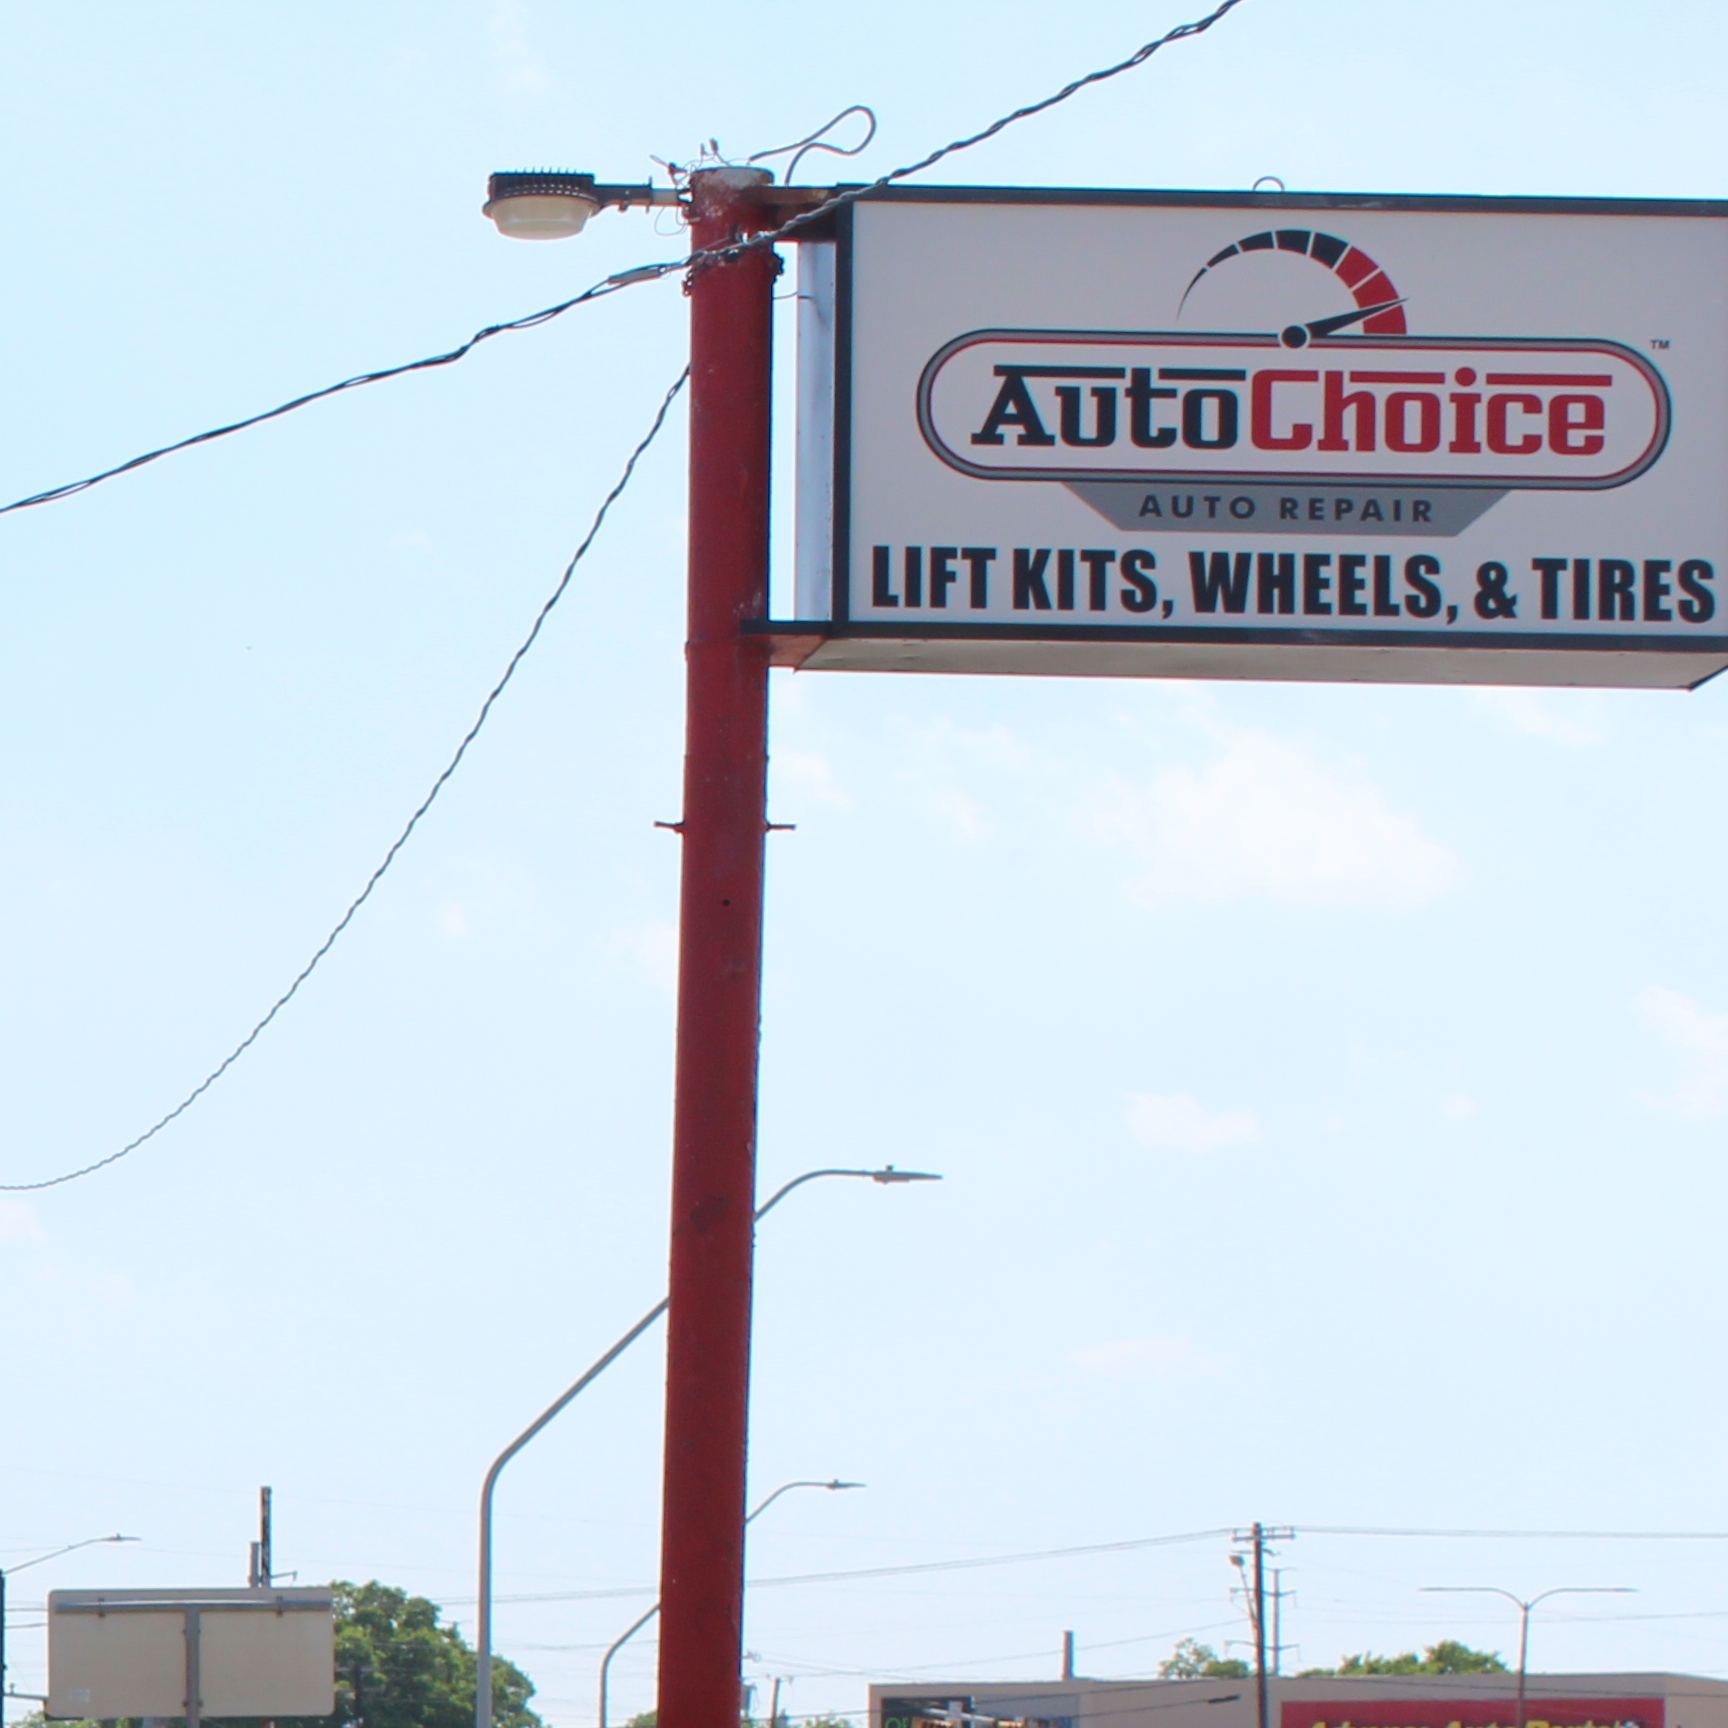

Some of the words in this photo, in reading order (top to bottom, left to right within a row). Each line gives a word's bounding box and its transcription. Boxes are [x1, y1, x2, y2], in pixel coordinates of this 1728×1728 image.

[971, 364, 1613, 456] AutoChoice
[1138, 493, 1256, 521] AUTO
[1279, 496, 1434, 524] REPAIR
[872, 545, 997, 609] LIFT
[1012, 548, 1174, 620] KITS,
[1189, 550, 1458, 625] WHEELS,
[1473, 560, 1518, 620] &
[1531, 556, 1716, 624] TIRES
